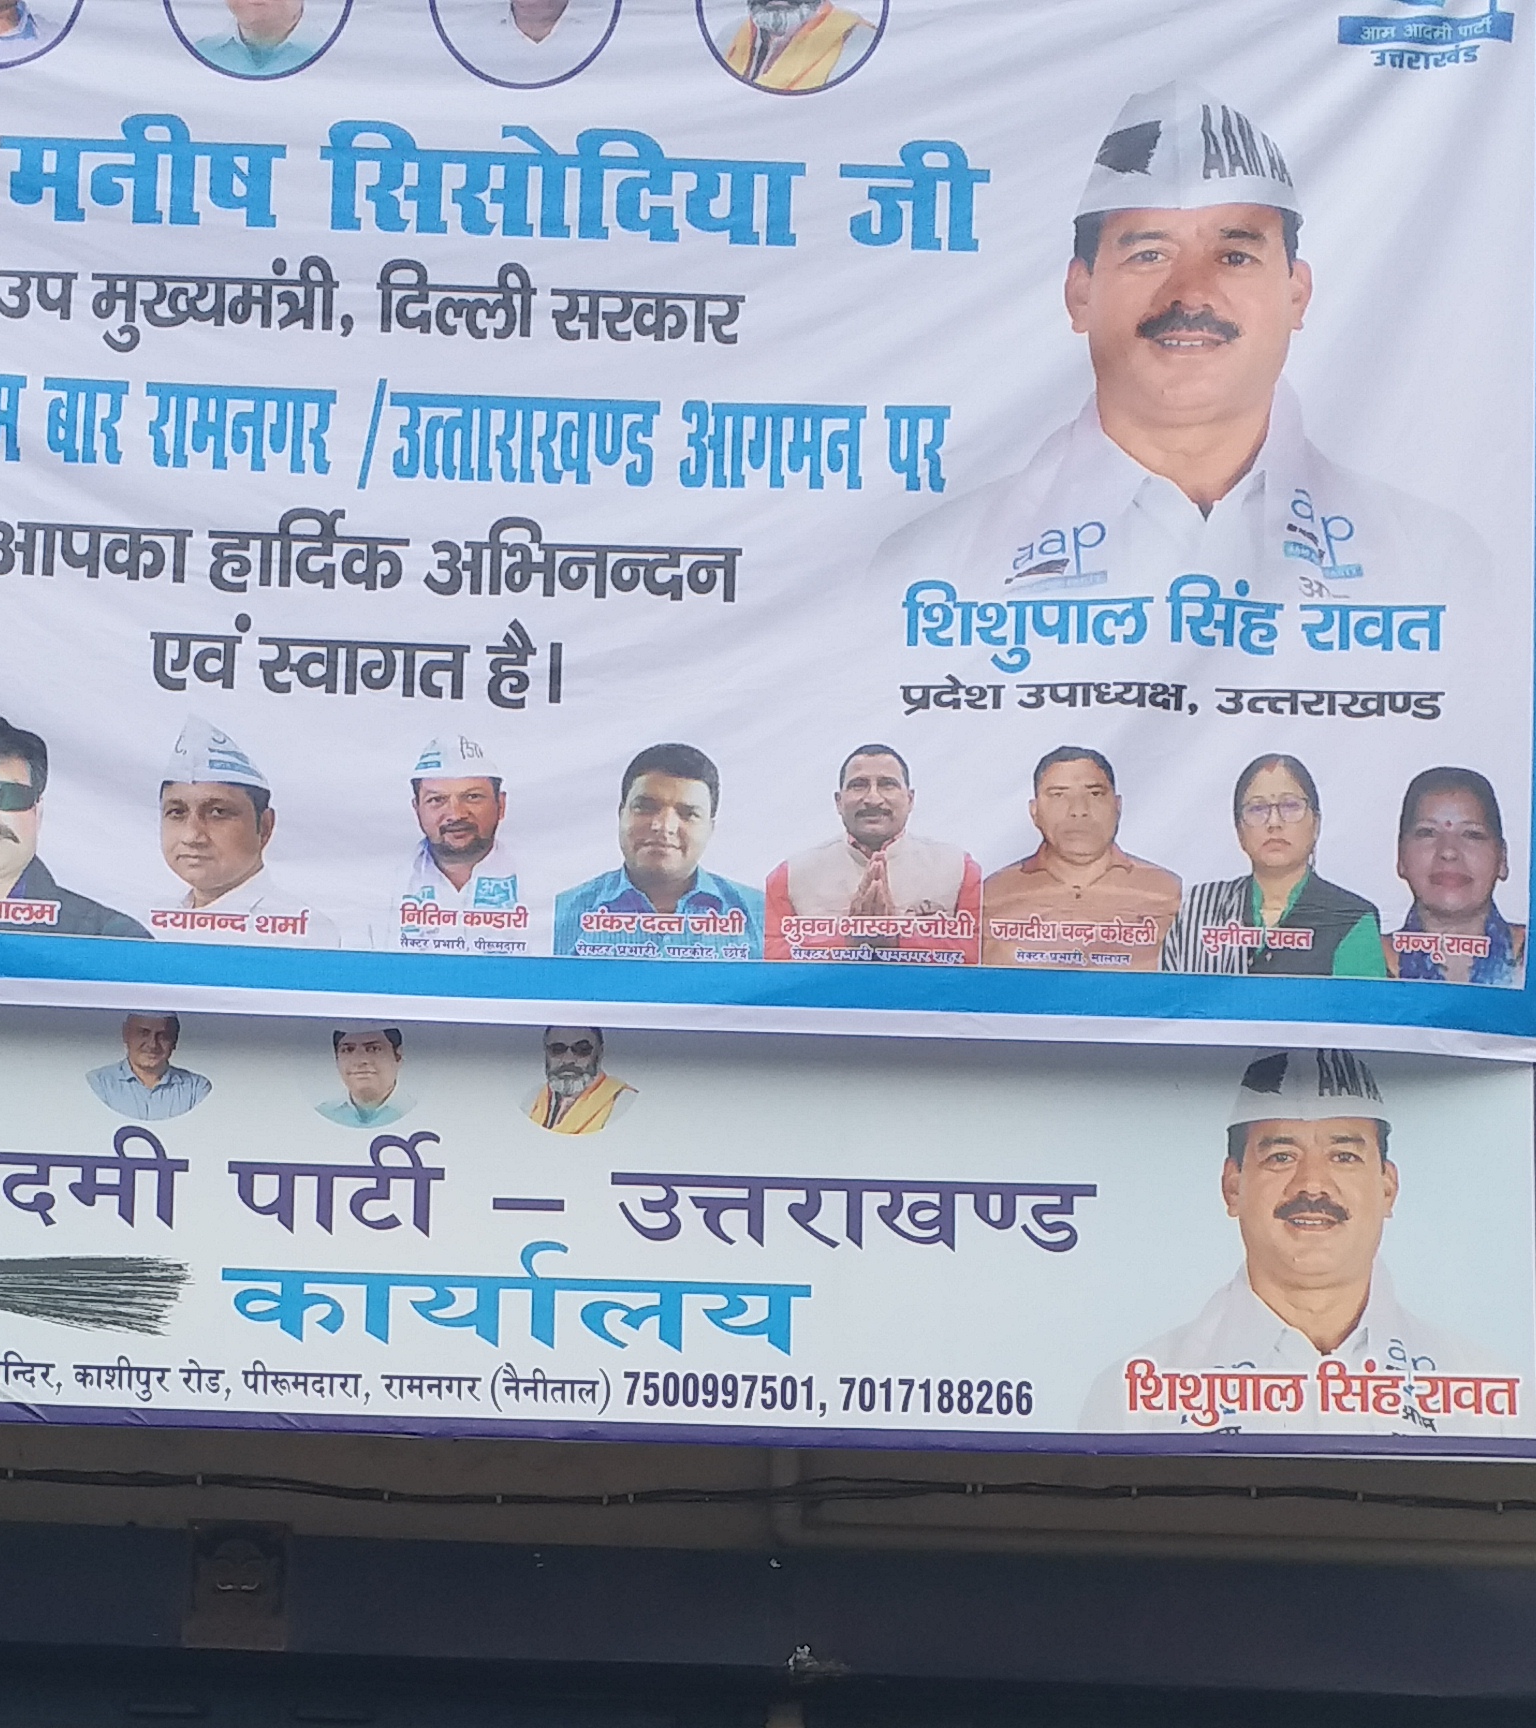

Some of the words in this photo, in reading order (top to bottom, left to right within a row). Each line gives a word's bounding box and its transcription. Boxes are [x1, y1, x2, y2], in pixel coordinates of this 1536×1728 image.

[1361, 26, 1395, 39] आम
[1403, 23, 1453, 40] आदमी
[1371, 43, 1480, 70] उत्तराखंड
[0, 114, 286, 228] मनीष
[319, 120, 806, 247] सिसोदिया
[840, 140, 990, 252] जी
[92, 256, 354, 352] मुख्यमंत्री,
[377, 259, 536, 337] दिल्ली
[552, 288, 745, 345] सरकार
[44, 375, 129, 466] बार
[146, 381, 336, 475] रामनगर
[679, 400, 867, 490] आगमन
[884, 405, 951, 493] पर
[208, 507, 409, 593] हार्दिक
[424, 517, 742, 602] अभिनन्दन
[902, 580, 1154, 673] शिशुपाल
[1166, 575, 1283, 654] सिंह
[1300, 603, 1446, 652] रावत
[151, 613, 252, 691] एवं
[258, 635, 470, 701] स्वागत
[899, 674, 1003, 715] प्रदेश
[1017, 679, 1198, 716] उपाध्यक्ष,
[1215, 688, 1445, 720] उत्तराखण्ड
[150, 910, 248, 935] दयानन्द
[254, 910, 308, 935] शर्मा
[400, 902, 457, 926] नितिन
[464, 904, 528, 928] कण्डारी
[582, 911, 635, 933] शंकर
[641, 915, 682, 934] दत्त
[688, 909, 746, 935] जोशी
[781, 916, 835, 942] भुवन
[839, 915, 912, 937] भास्कर
[916, 914, 974, 938] जोशी
[991, 918, 1057, 941] जगदीश
[1061, 922, 1093, 945] चन्द्र
[1099, 917, 1157, 943] कोहली
[1203, 922, 1261, 954] सुनीता
[1266, 926, 1312, 950] रावत
[1394, 932, 1442, 961] मन्जू
[1445, 934, 1489, 957] रावत
[228, 1131, 445, 1237] पार्टी
[611, 1171, 1097, 1253] उत्तराखण्ड
[222, 1240, 812, 1356] कार्यालय
[73, 1353, 170, 1399] काशीपुर
[179, 1358, 230, 1400] रोड,
[243, 1364, 370, 1406] पीरूमदारा,
[381, 1374, 480, 1405] रामनगर
[490, 1363, 613, 1409] (नैनीताल)
[624, 1370, 827, 1418] 7500997501,
[840, 1377, 1034, 1417] 7017188266
[1125, 1358, 1308, 1426] शिशुपाल
[1316, 1354, 1404, 1415] सिंह
[1414, 1377, 1520, 1416] रावत
